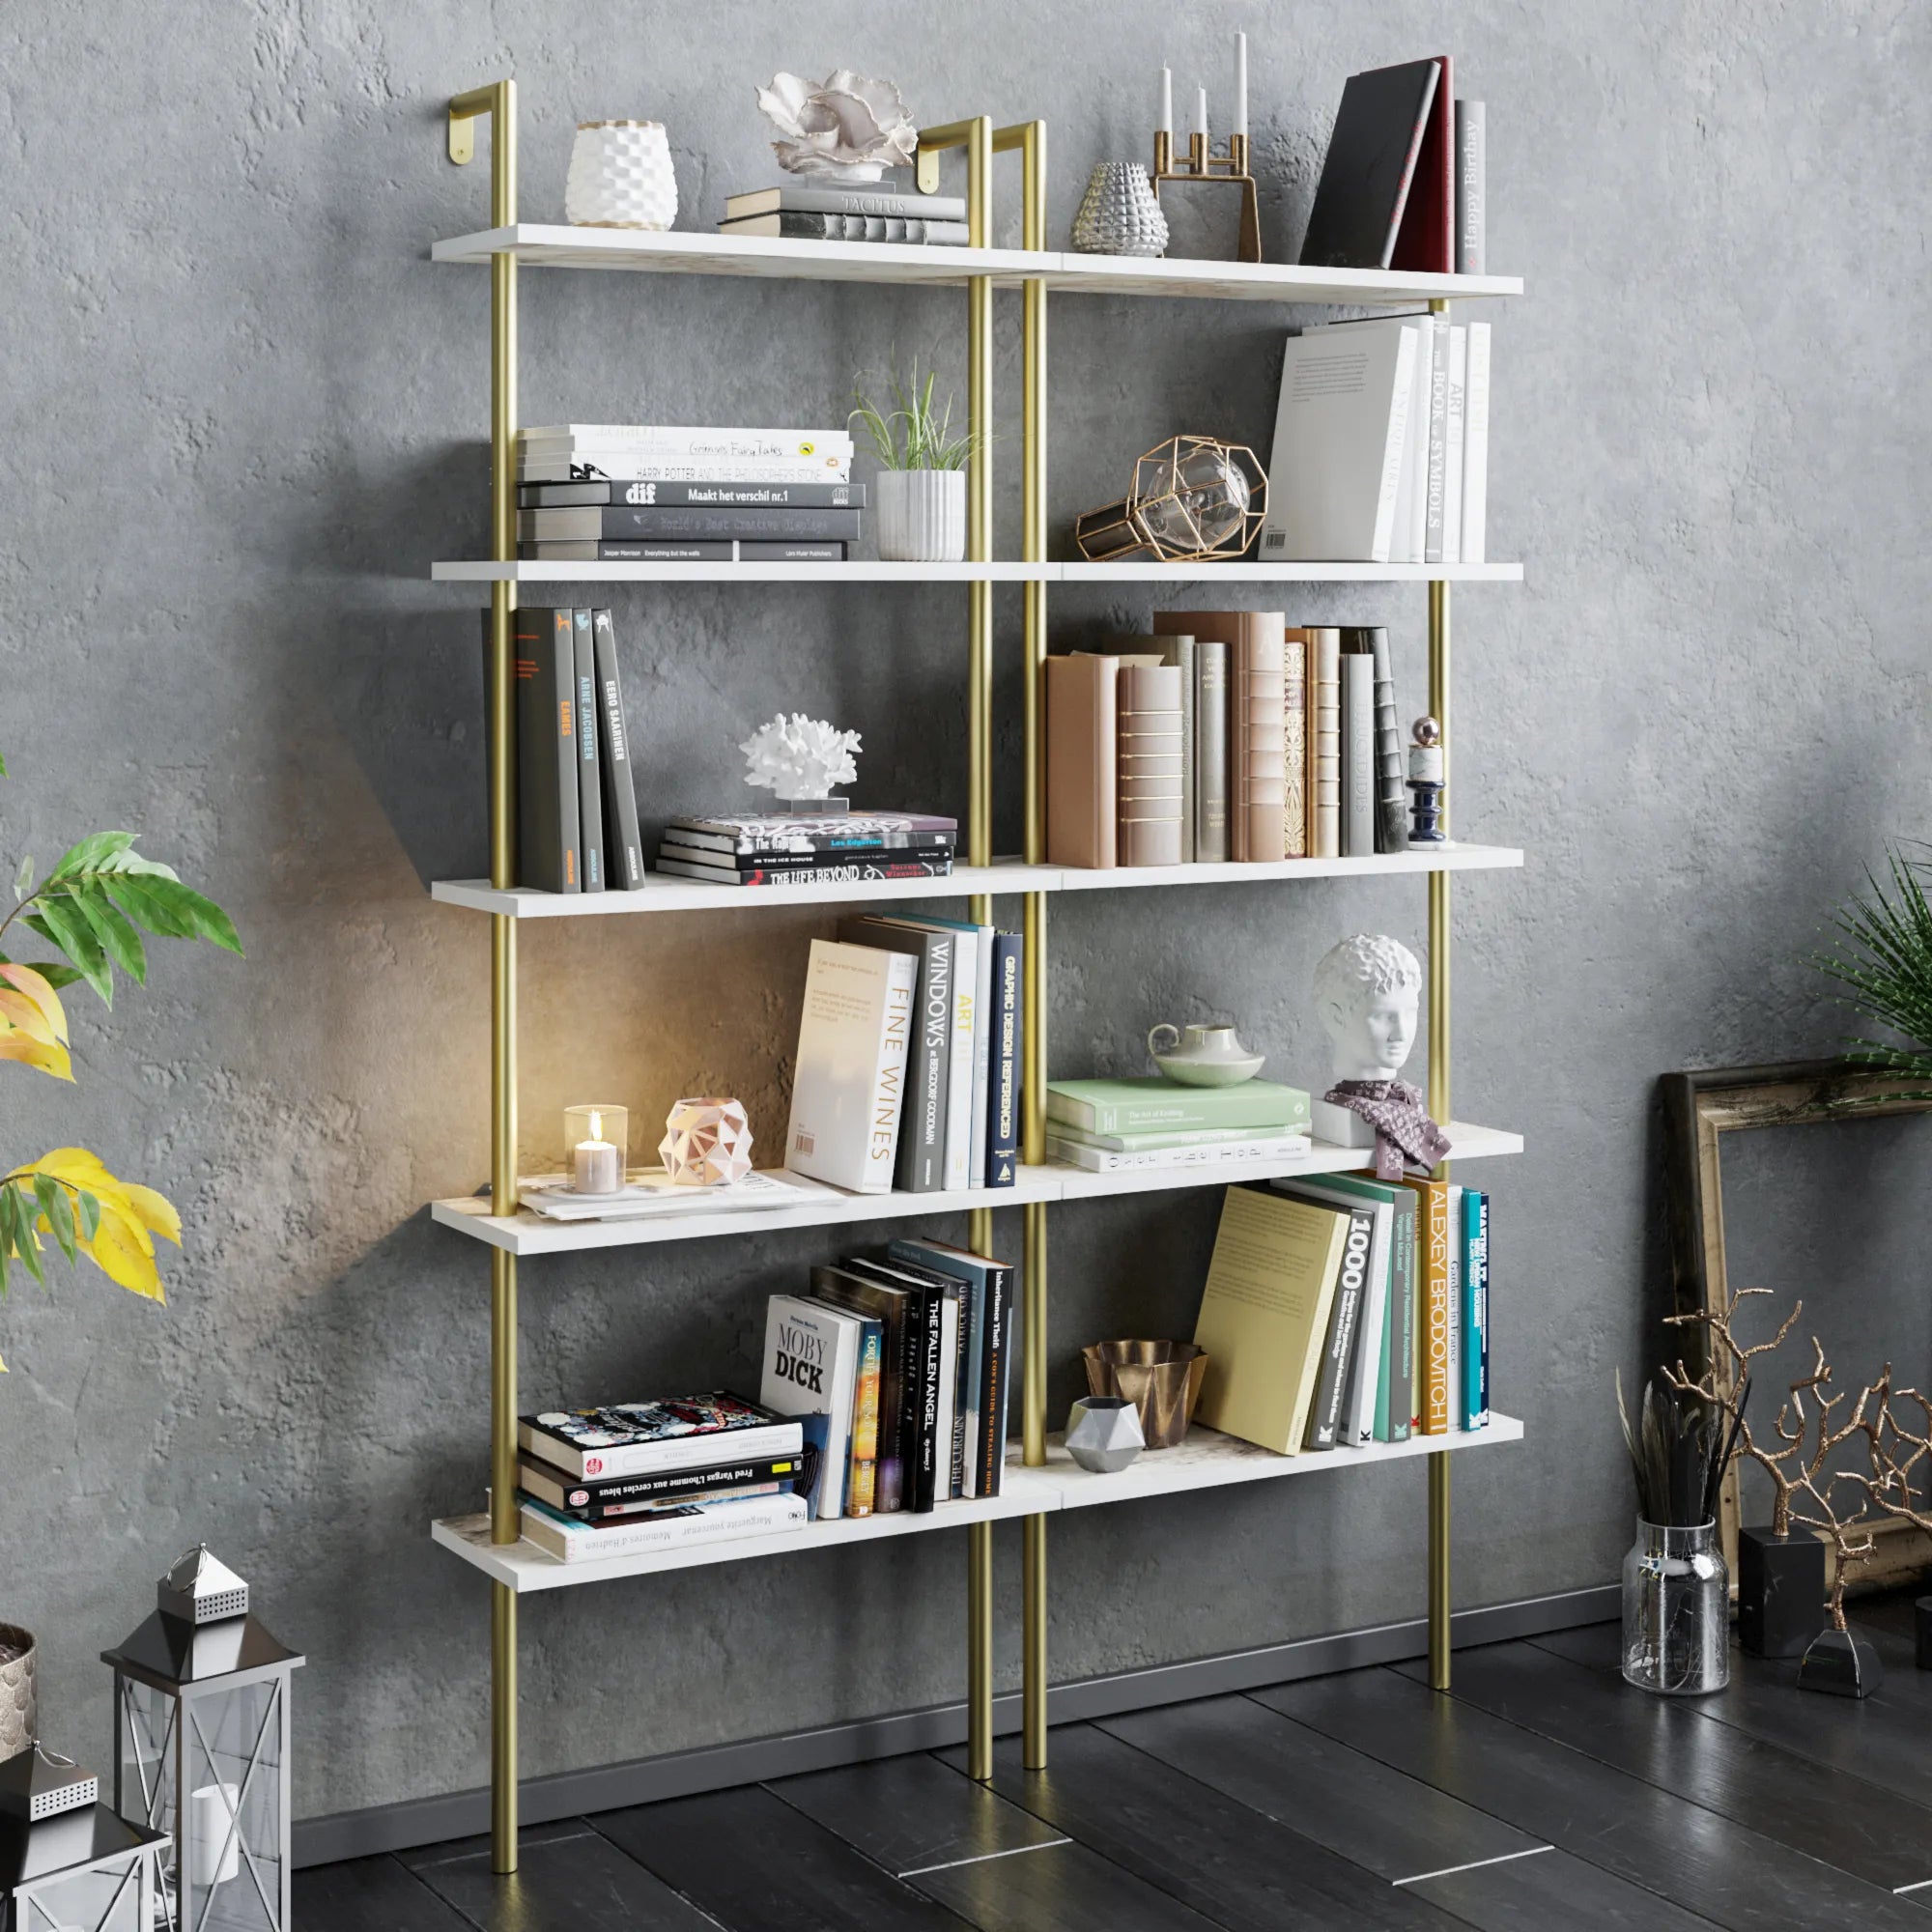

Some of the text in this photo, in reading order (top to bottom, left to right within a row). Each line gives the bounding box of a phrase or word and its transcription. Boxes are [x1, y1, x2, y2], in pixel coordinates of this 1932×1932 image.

[842, 196, 905, 213] TACITUS
[1464, 189, 1481, 250] Happy
[1432, 370, 1446, 421] BOOK
[1449, 383, 1463, 420] ART
[626, 482, 657, 505] dif
[637, 468, 661, 480] HARRY
[665, 468, 696, 481] POTTER
[688, 490, 788, 502] Maakt het verschil nr.1
[1428, 440, 1443, 529] SYMBOLS
[561, 700, 572, 736] EAMES
[580, 676, 594, 760] ARNE JACOBSEN
[605, 680, 625, 761] EERO SAARINEN
[770, 866, 859, 885] THE LIFE BEYOND
[926, 941, 949, 1048] WINDOWS
[1005, 955, 1015, 1010] GRAPHIC
[956, 994, 973, 1033] ART
[1003, 1012, 1014, 1057] DESIGN
[870, 987, 910, 1161] FINE WINES
[926, 1058, 939, 1100] BERGDORF
[1000, 1060, 1013, 1140] REFERENCED
[924, 1101, 936, 1145] GOODMAN
[1342, 1217, 1371, 1290] 1000
[1403, 1242, 1412, 1293] Contemporary
[992, 1270, 1003, 1322] Inheritance
[1431, 1188, 1447, 1420] ALEXEY BRODOVITCH
[1450, 1260, 1460, 1308] Gardens
[1451, 1312, 1460, 1321] in
[778, 1322, 828, 1365] MOBY
[924, 1300, 940, 1431] THE FALLEN ANGEL
[775, 1350, 823, 1395] DICK
[988, 1415, 995, 1426] TO
[951, 1416, 964, 1486] THE CURTAIN
[599, 1467, 753, 1497] Fred Vargas L'homme aux cercles bleus
[585, 1537, 628, 1550] d'Hadrien
[727, 1514, 773, 1531] Marguerite
